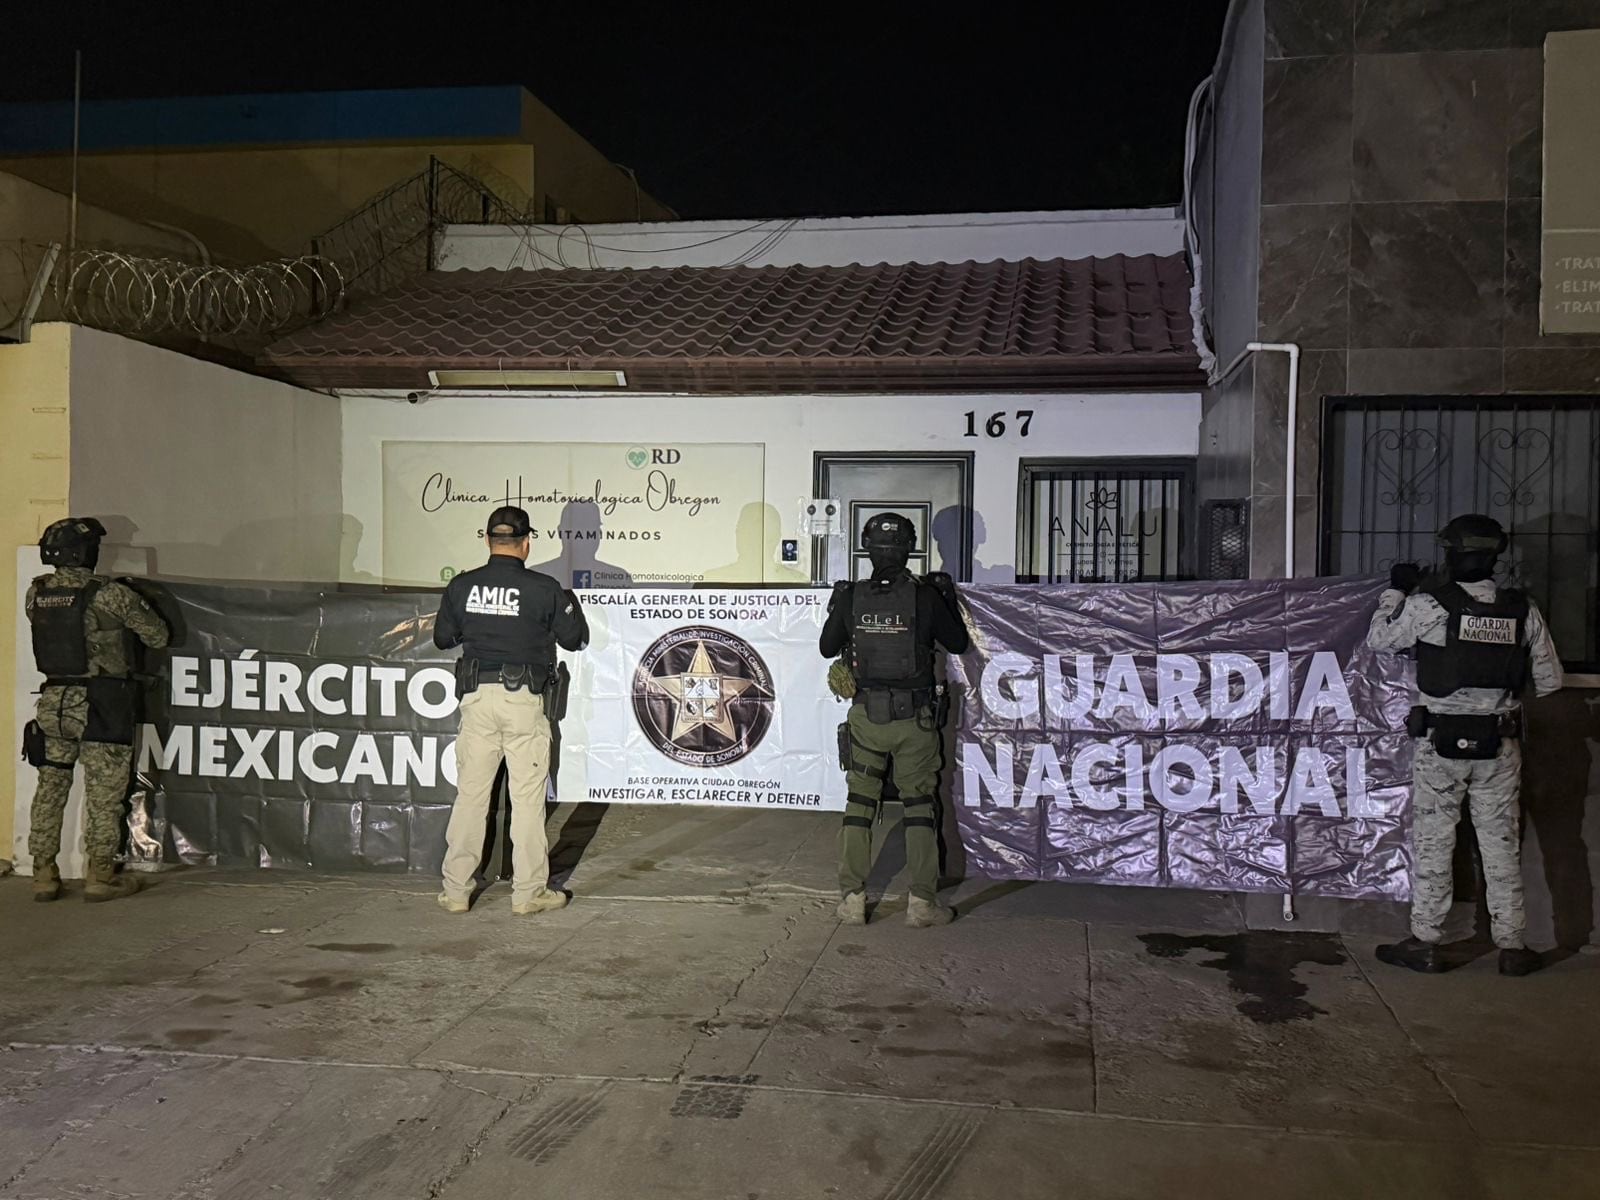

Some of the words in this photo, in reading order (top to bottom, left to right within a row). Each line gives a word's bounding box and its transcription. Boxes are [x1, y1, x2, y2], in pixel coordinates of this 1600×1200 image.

[963, 410, 1034, 438] 167
[651, 448, 681, 465] RD
[421, 472, 490, 513] Clinica
[646, 469, 721, 517] Obregon
[547, 530, 662, 541] VITAMINADOS
[594, 571, 624, 581] Clinica
[467, 584, 520, 606] AMIC
[580, 592, 638, 606] FISCALÍA
[641, 594, 705, 606] GENERAL
[708, 594, 727, 606] DE
[730, 594, 791, 607] JUSTICIA
[794, 594, 821, 607] DEL
[630, 608, 683, 620] ESTADO
[687, 608, 705, 620] DE
[708, 608, 769, 621] SONORA
[1467, 616, 1511, 631] GUARDIA
[1463, 628, 1512, 642] NACIONAL
[170, 648, 460, 720] EJÉRCITO
[979, 650, 1357, 721] GUARDIA
[627, 776, 650, 785] BASE
[651, 776, 700, 786] OPERATIVA
[701, 777, 736, 787] CIUDAD
[737, 778, 781, 789] OBREGÓN
[961, 742, 1388, 819] NACIONAL
[671, 789, 752, 803] ESCLARECER
[754, 792, 764, 803] Y
[767, 793, 821, 806] DETENER
